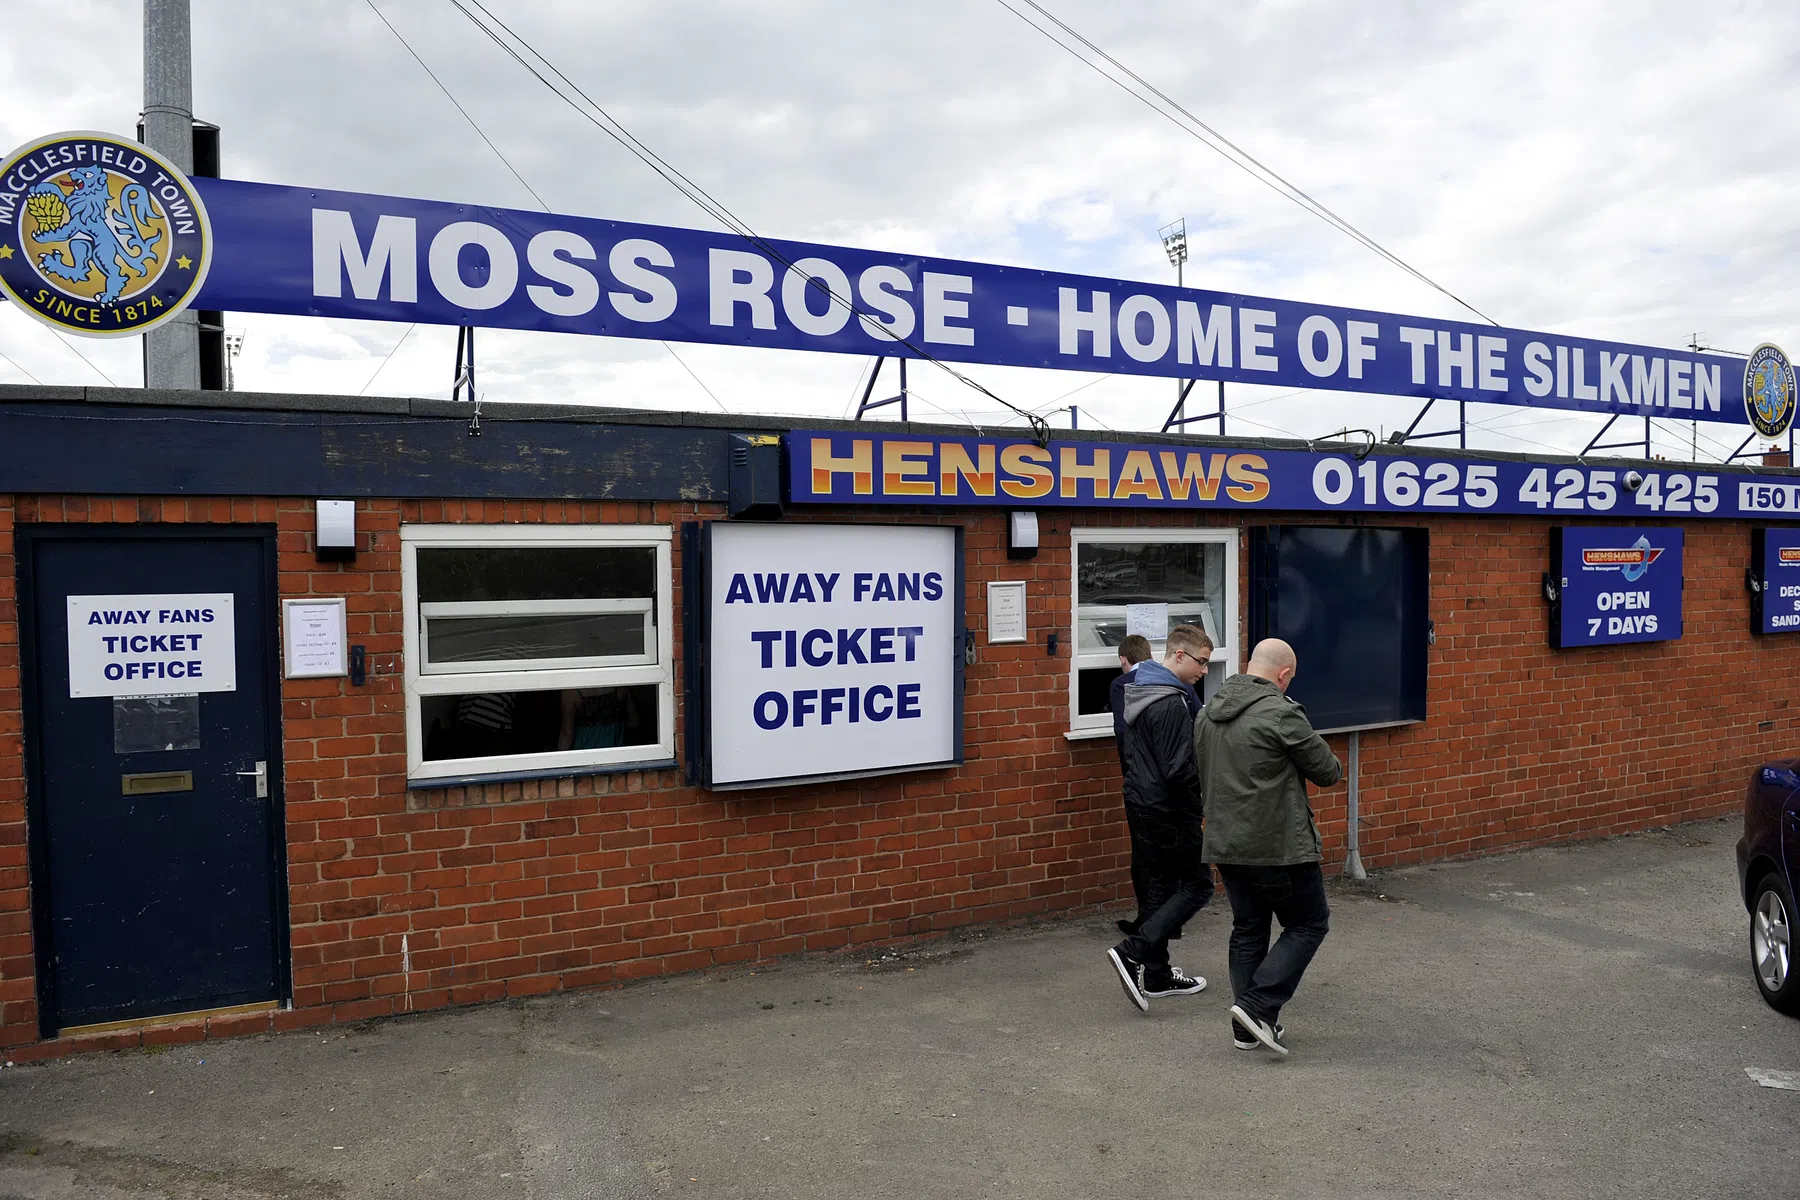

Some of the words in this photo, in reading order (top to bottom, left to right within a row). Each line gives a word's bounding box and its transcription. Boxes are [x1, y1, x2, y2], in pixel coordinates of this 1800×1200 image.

[0, 144, 147, 225] MACCLESFIELD
[152, 171, 196, 235] TOWN
[33, 288, 101, 324] SINCE
[113, 294, 164, 323] 1874
[312, 208, 678, 323] MOSS
[708, 248, 975, 347] ROSE
[1058, 286, 1279, 372] HOME
[1297, 315, 1379, 379] OF
[1400, 326, 1509, 392] THE
[1523, 341, 1721, 412] SILKMEN
[1747, 348, 1783, 388] MACCLESFIELD
[1782, 360, 1794, 391] TOWN
[1754, 417, 1771, 434] SINCE
[1773, 419, 1787, 433] 1874
[810, 438, 1270, 503] HENSHAWS
[1312, 457, 1498, 508] 01625
[1518, 468, 1617, 511] 425
[1635, 473, 1719, 513] 425
[1746, 486, 1786, 509] 150
[1586, 551, 1642, 562] HENSHAWS
[725, 573, 841, 604] AWAY
[853, 572, 943, 602] FANS
[1597, 591, 1650, 611] OPEN
[88, 610, 151, 625] AWAY
[158, 608, 215, 624] FANS
[1133, 607, 1156, 619] CASH
[1588, 618, 1602, 637] 7
[1608, 614, 1658, 636] DAYS
[102, 633, 203, 654] TICKET
[751, 626, 924, 669] TICKET
[103, 660, 203, 681] OFFICE
[753, 683, 922, 731] OFFICE
